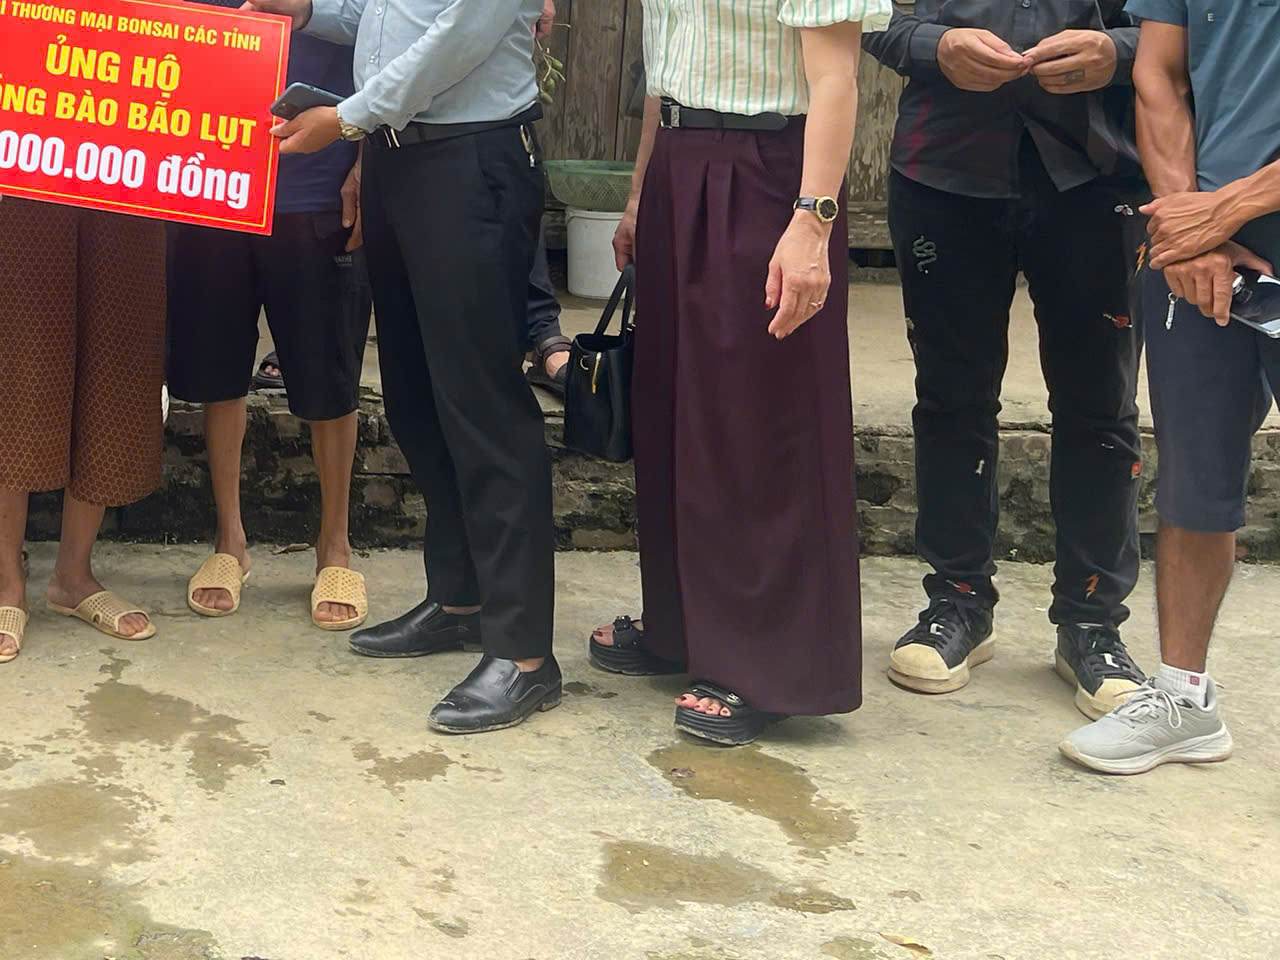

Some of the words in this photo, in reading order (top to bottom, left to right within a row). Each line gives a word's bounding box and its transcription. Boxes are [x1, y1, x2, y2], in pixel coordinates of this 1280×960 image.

[11, 0, 77, 25] THƯƠNG
[80, 10, 114, 32] MẠI
[117, 16, 180, 40] BONSAI
[183, 24, 218, 46] CÁC
[222, 27, 262, 52] TỈNH
[45, 33, 121, 84] ỦNG
[131, 53, 181, 99] HỘ
[55, 89, 119, 126] BÀO
[127, 100, 191, 137] BÃO
[199, 112, 257, 150] LỤT
[156, 151, 251, 210] đồng
